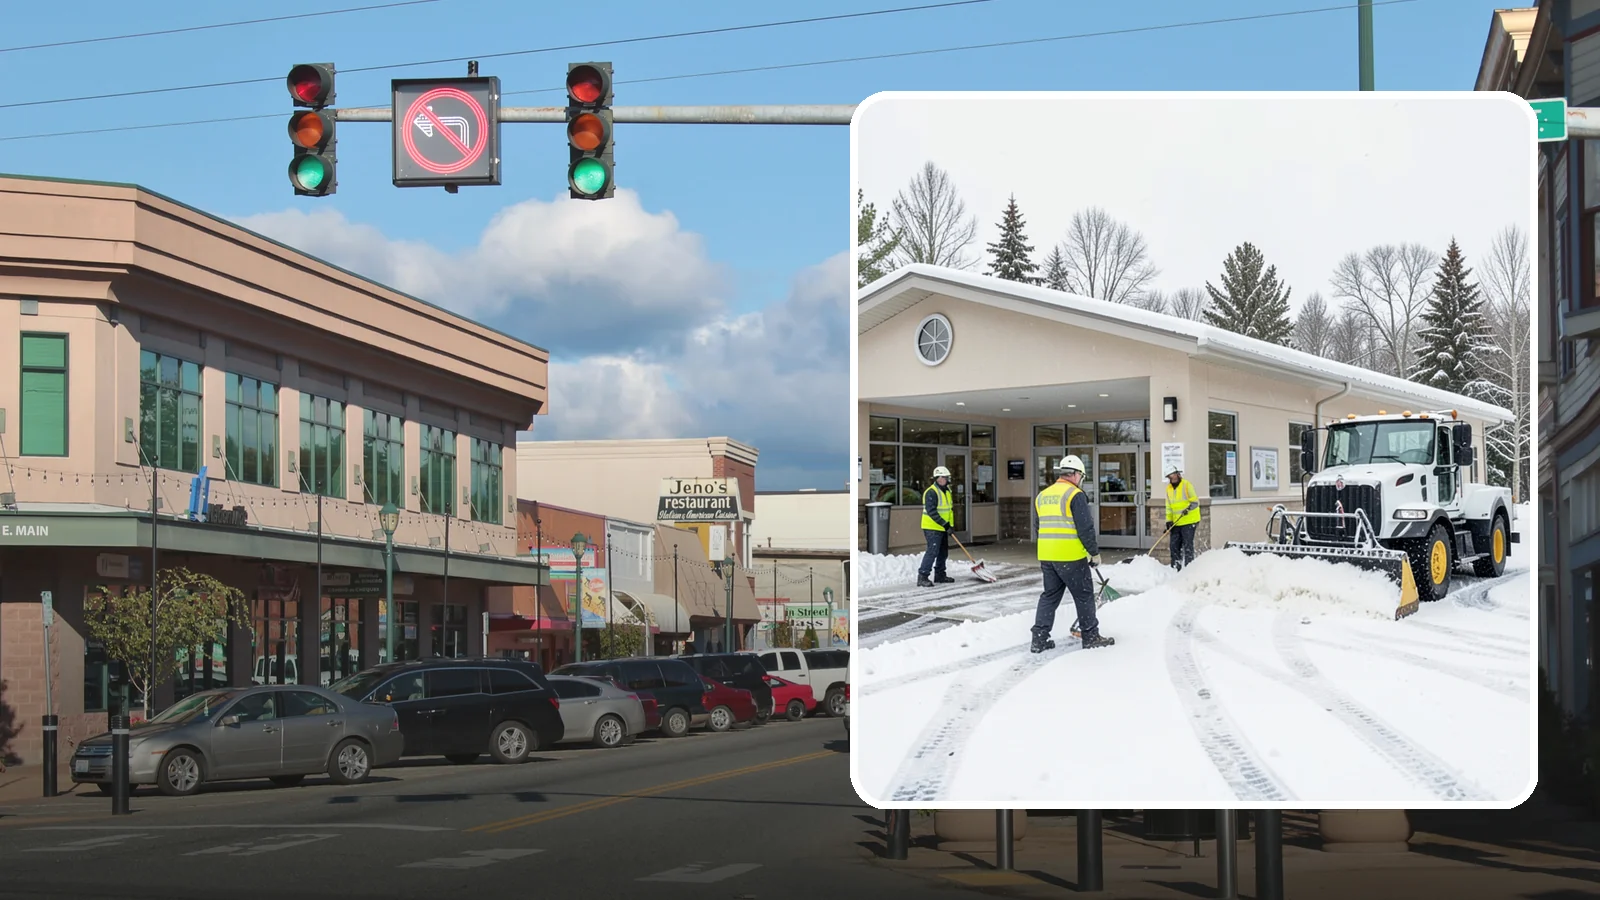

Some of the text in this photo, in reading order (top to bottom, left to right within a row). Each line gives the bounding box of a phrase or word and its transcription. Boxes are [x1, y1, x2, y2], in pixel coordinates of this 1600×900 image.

[669, 480, 728, 494] Jeno's
[665, 496, 731, 509] restaurant
[686, 509, 714, 519] American
[715, 509, 738, 519] Cuisine
[2, 525, 49, 536] E. MAIN
[797, 607, 829, 617] Street
